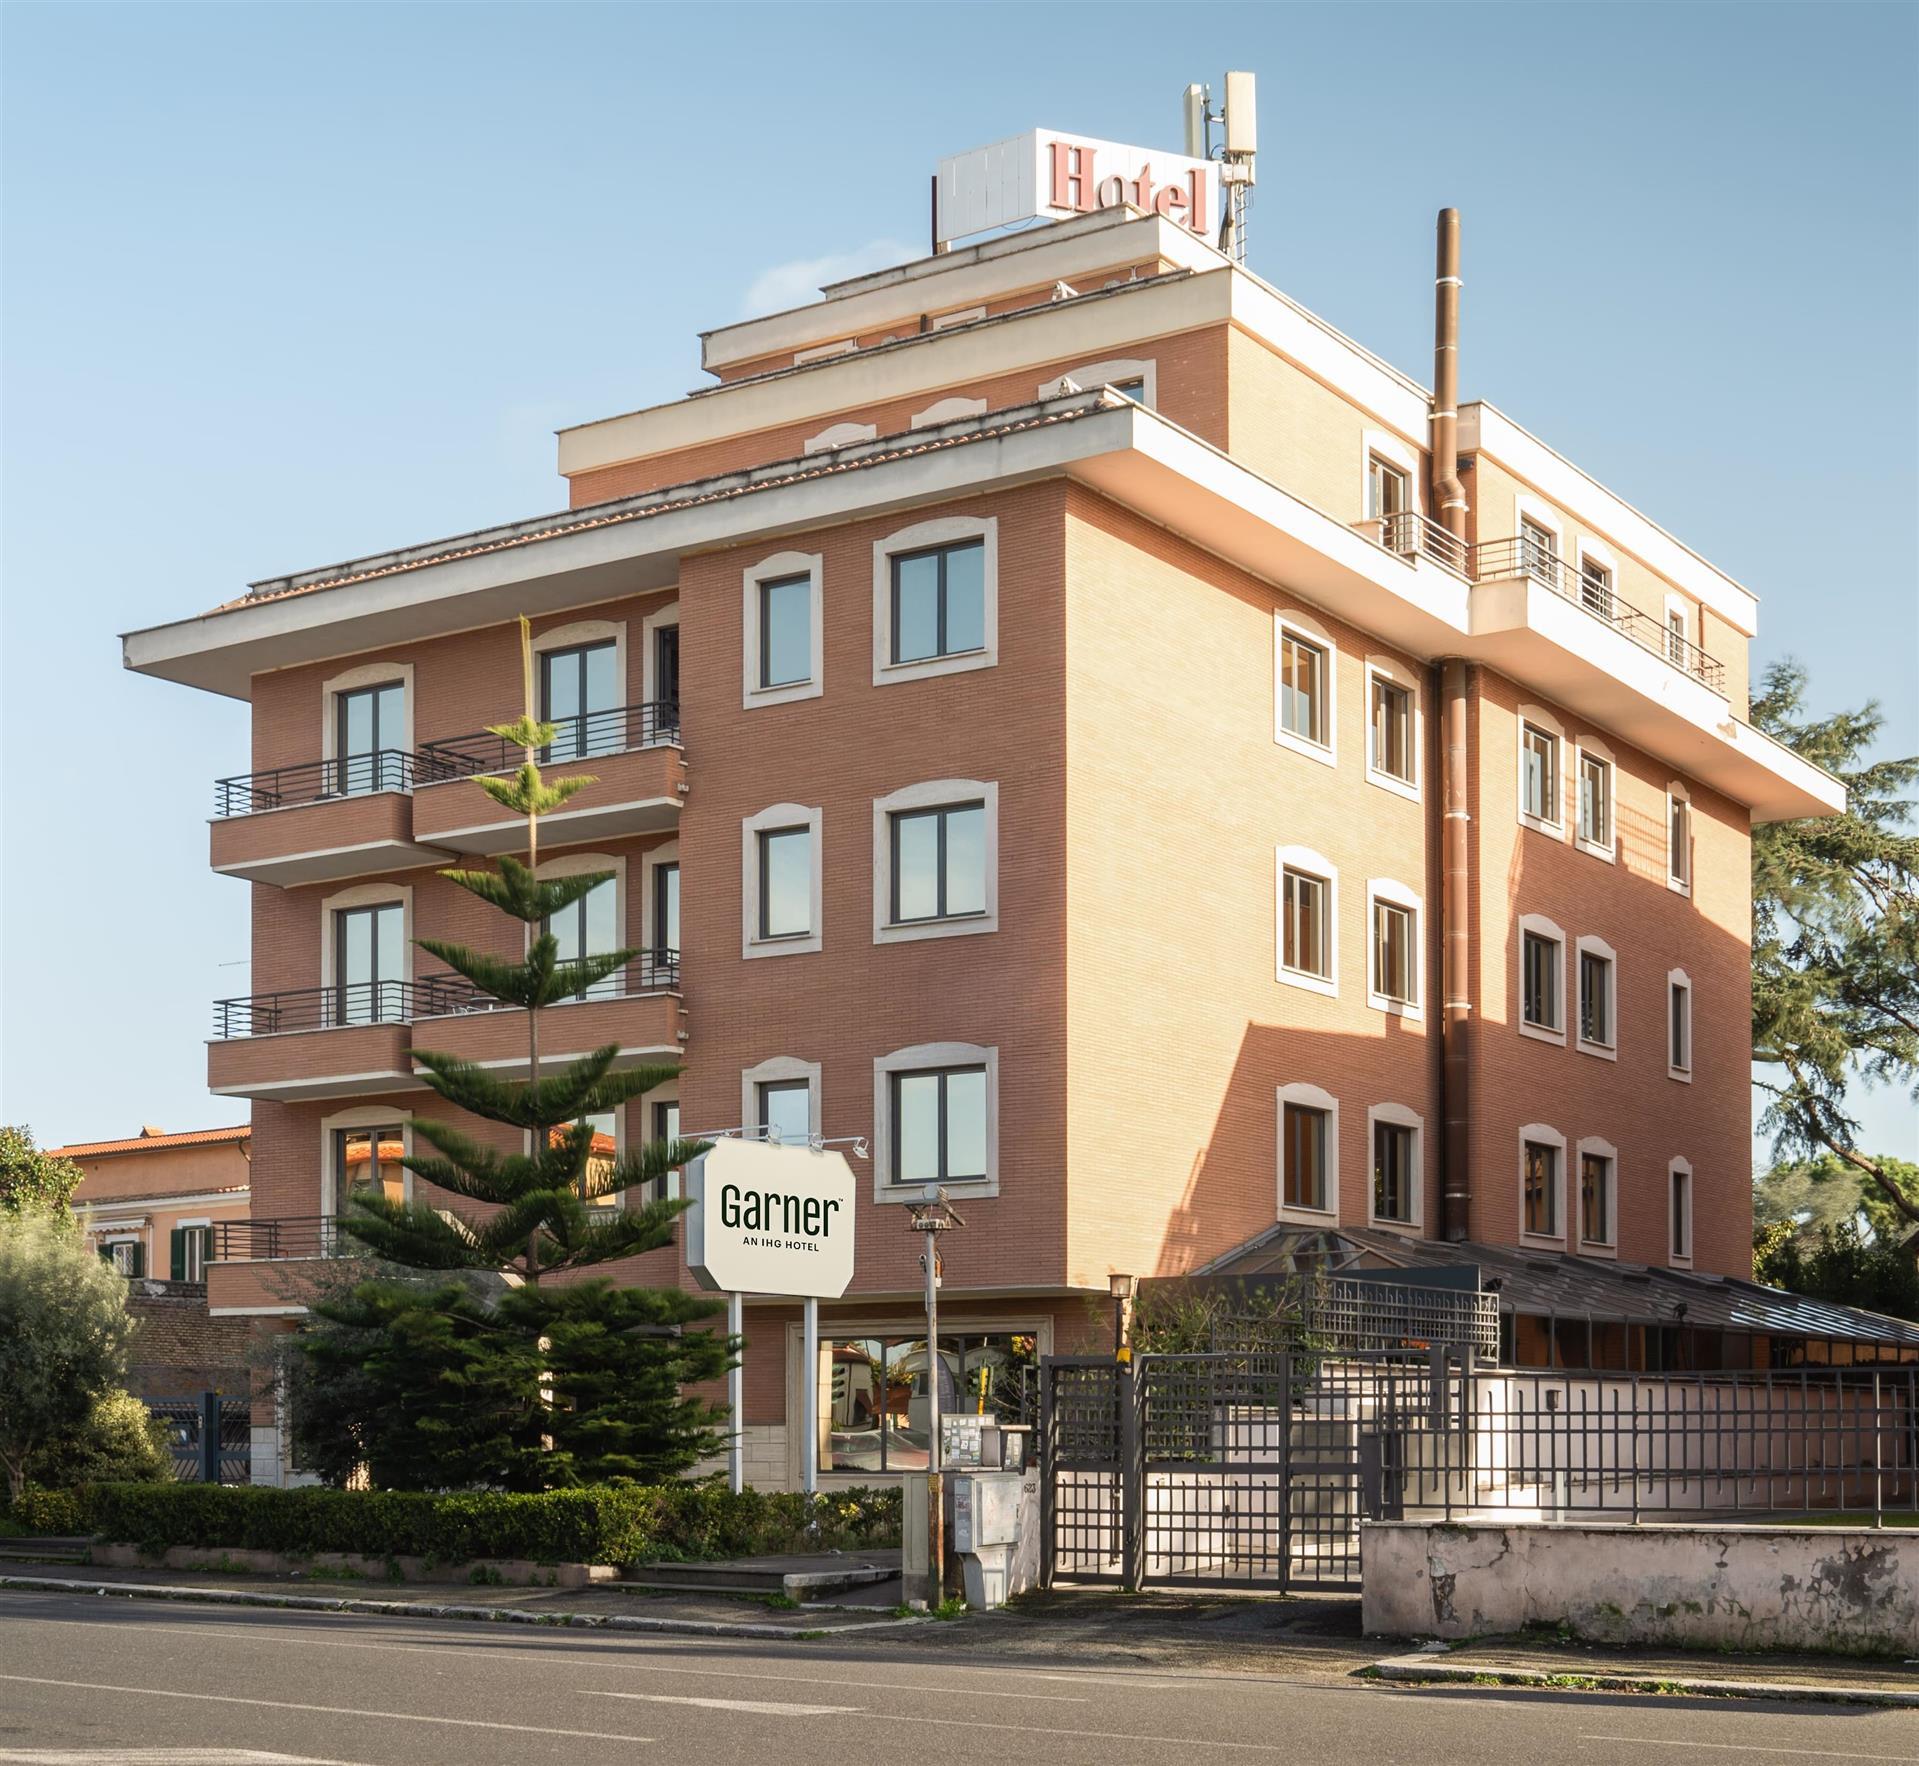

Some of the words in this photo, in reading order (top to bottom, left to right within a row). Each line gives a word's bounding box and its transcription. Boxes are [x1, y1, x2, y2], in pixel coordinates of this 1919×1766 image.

[1048, 140, 1208, 235] Hotel
[742, 1236, 758, 1246] AN
[761, 1238, 782, 1248] IHG
[785, 1240, 820, 1252] HOTEL
[1024, 1483, 1036, 1494] 623
